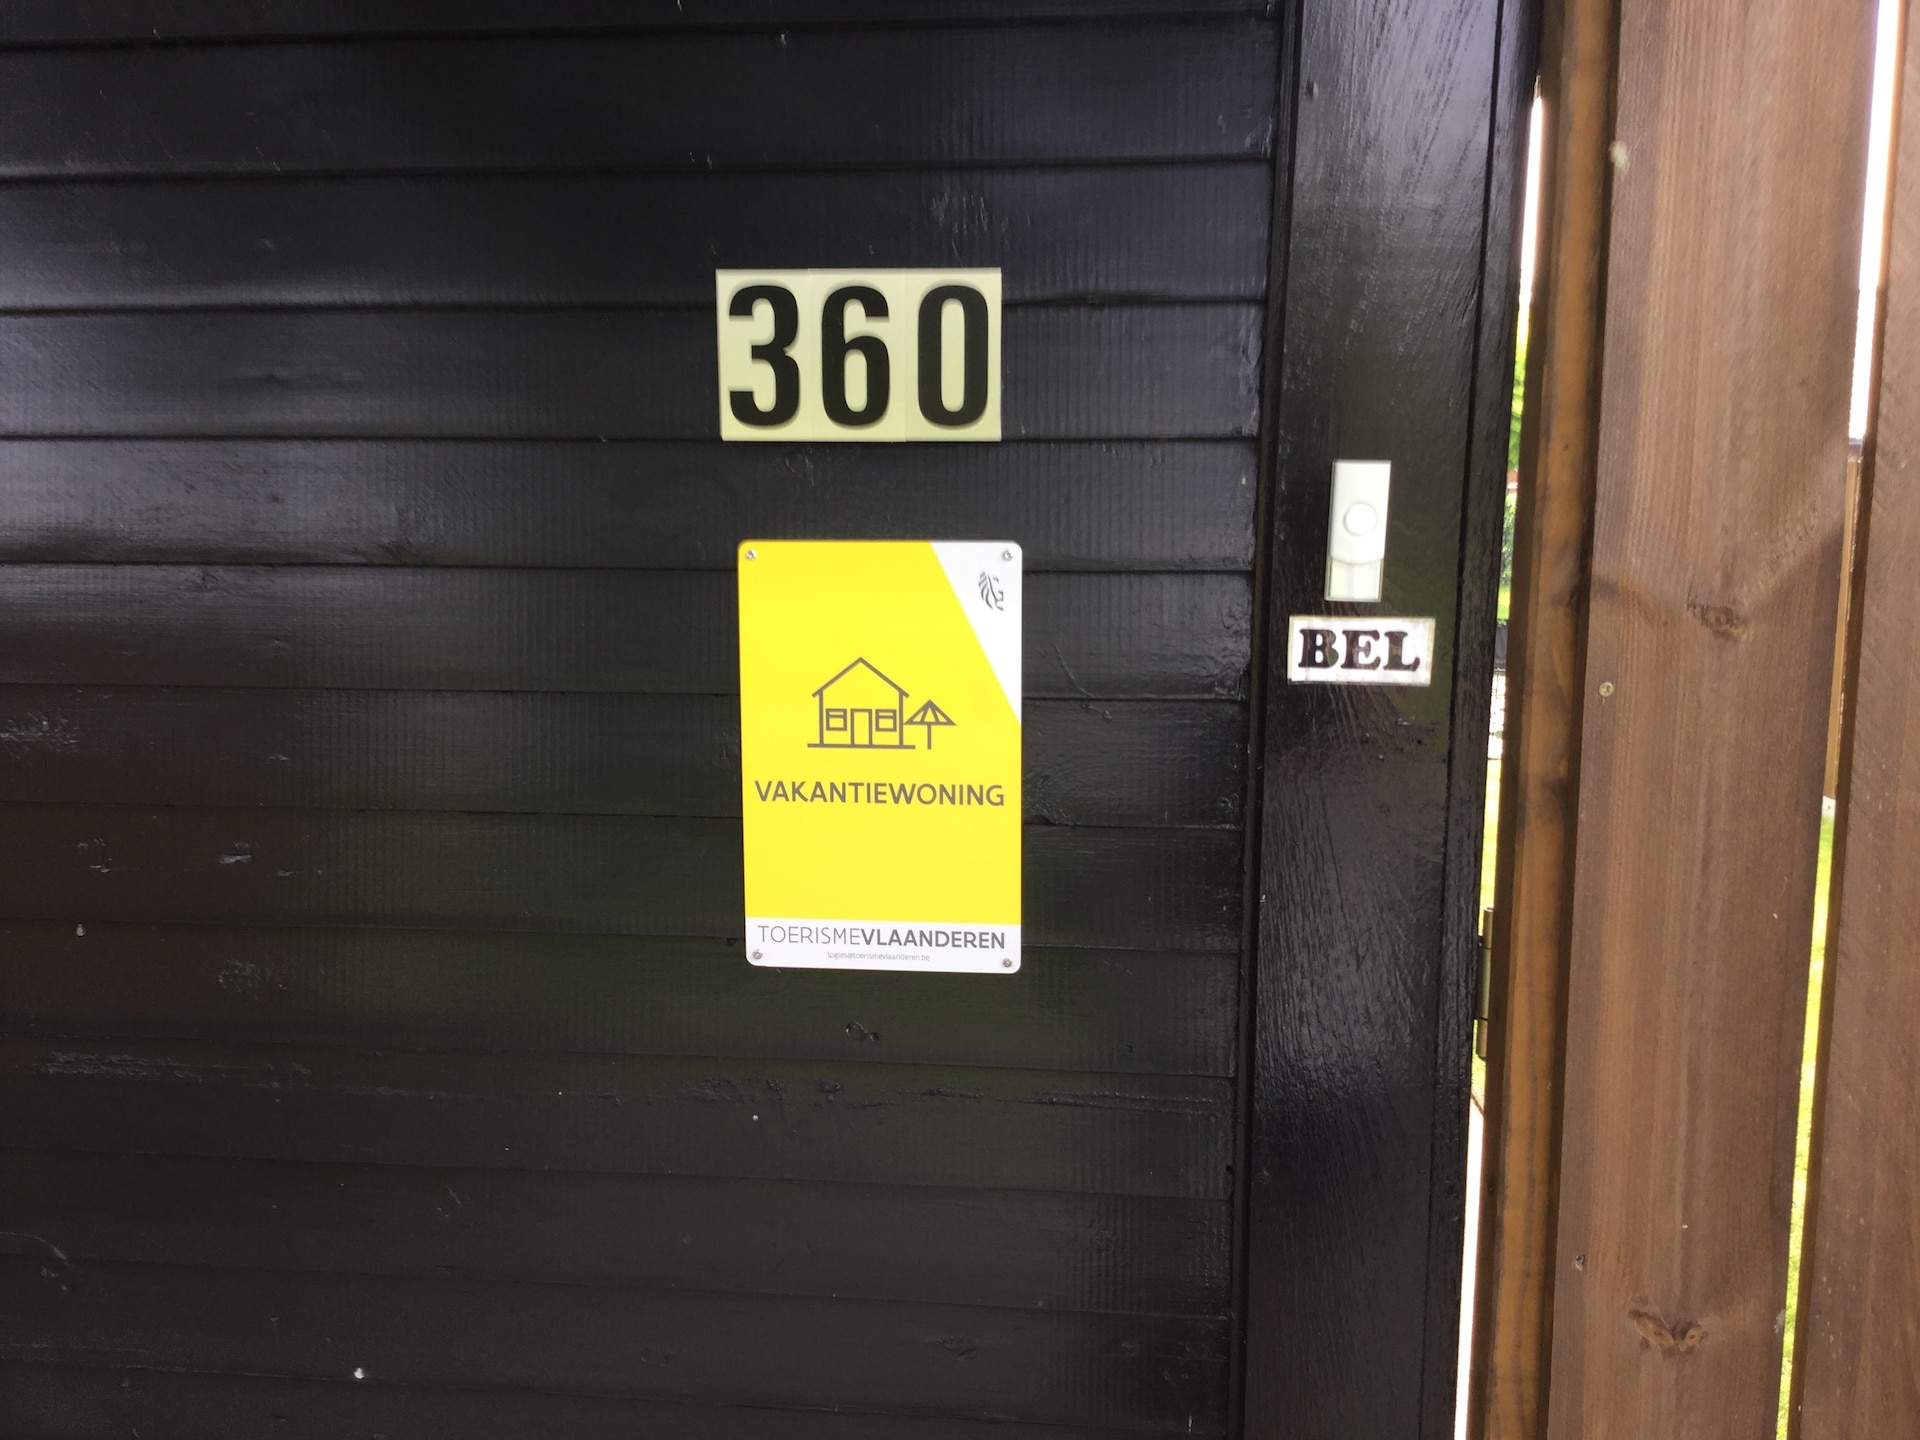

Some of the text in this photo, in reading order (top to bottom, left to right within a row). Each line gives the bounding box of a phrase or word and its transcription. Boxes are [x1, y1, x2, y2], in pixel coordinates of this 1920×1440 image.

[728, 284, 989, 426] 360
[1298, 629, 1421, 672] BEL
[754, 780, 1005, 807] VAKANTIEWONING
[757, 924, 1006, 950] TOERISMEVLAANDEREN
